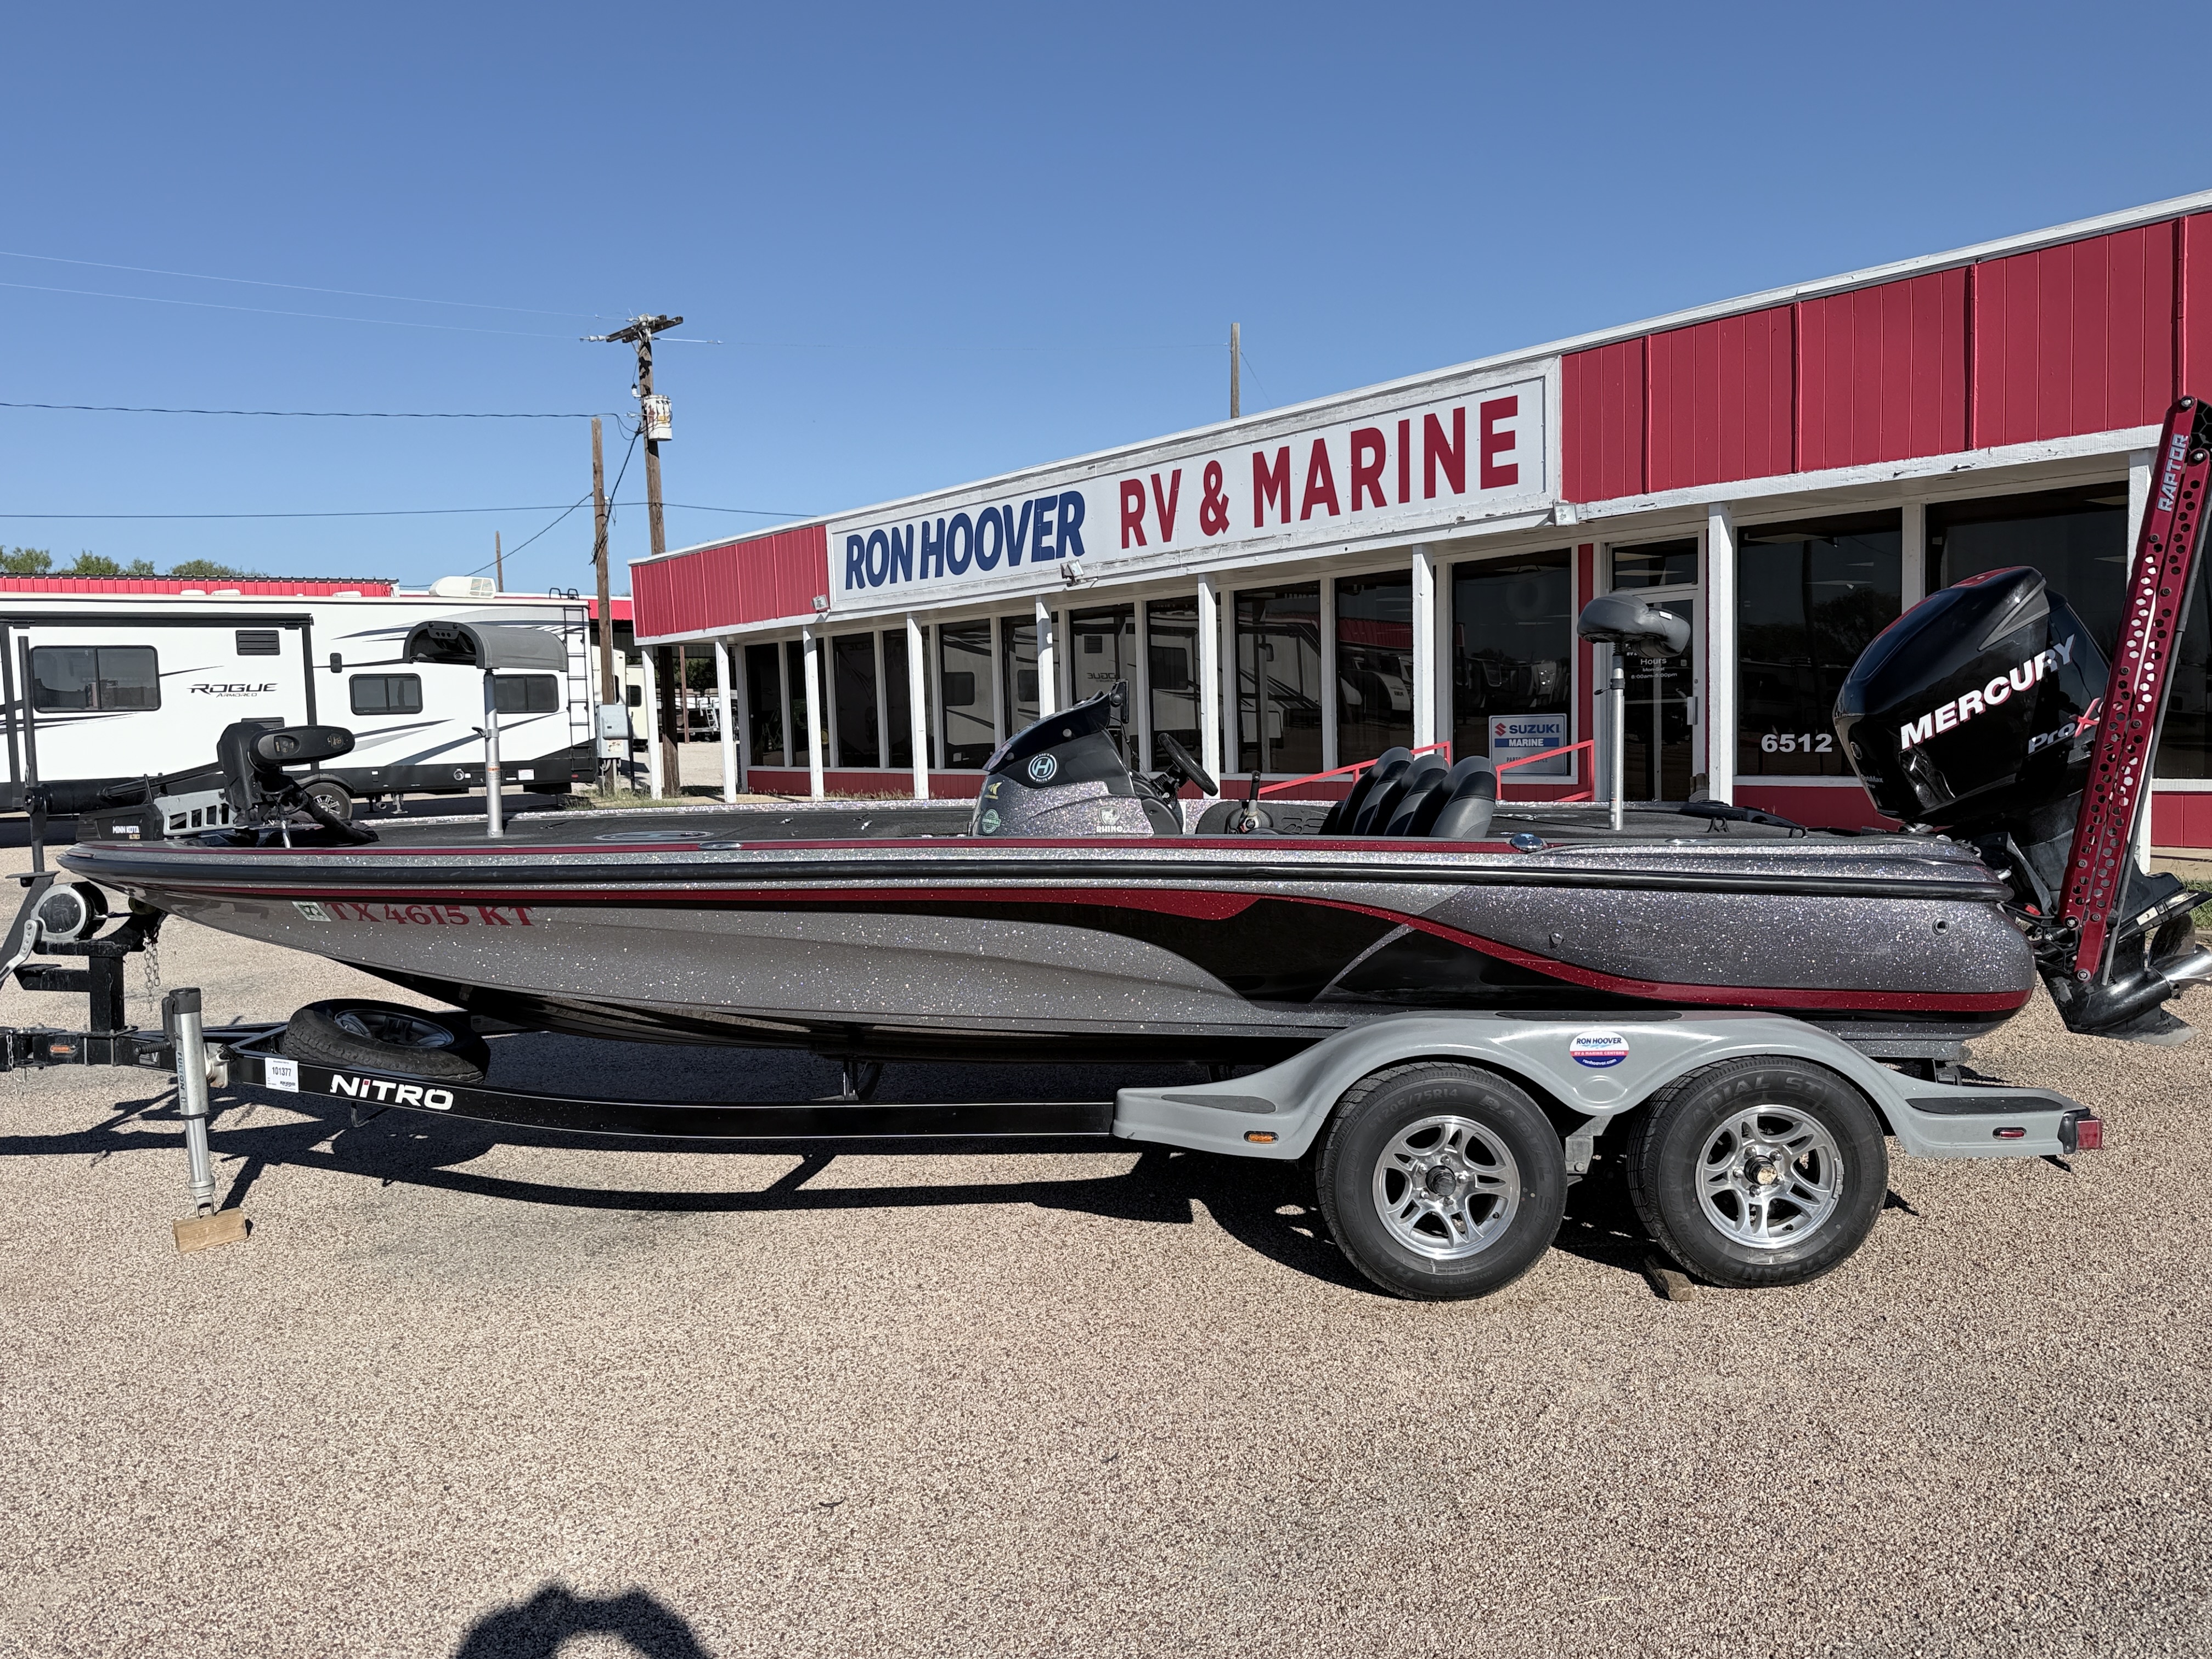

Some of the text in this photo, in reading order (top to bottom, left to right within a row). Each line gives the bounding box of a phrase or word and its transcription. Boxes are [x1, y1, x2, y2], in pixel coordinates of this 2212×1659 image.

[2157, 433, 2189, 512] RAPTOR
[845, 395, 1519, 590] RON HOOVER RV & MARINE
[186, 683, 279, 695] ROGUE
[1900, 634, 2076, 750] MERCURY
[1509, 724, 1560, 734] SUZUKI
[1509, 738, 1544, 747] MARINE
[1760, 733, 1833, 753] 6512
[126, 825, 140, 833] KOTA
[1096, 825, 1123, 833] RHINO
[323, 902, 535, 926] TX 4615 KT
[177, 1052, 185, 1090] FULTON
[272, 1066, 291, 1077] 101377
[1678, 1075, 1771, 1144] RADIAL
